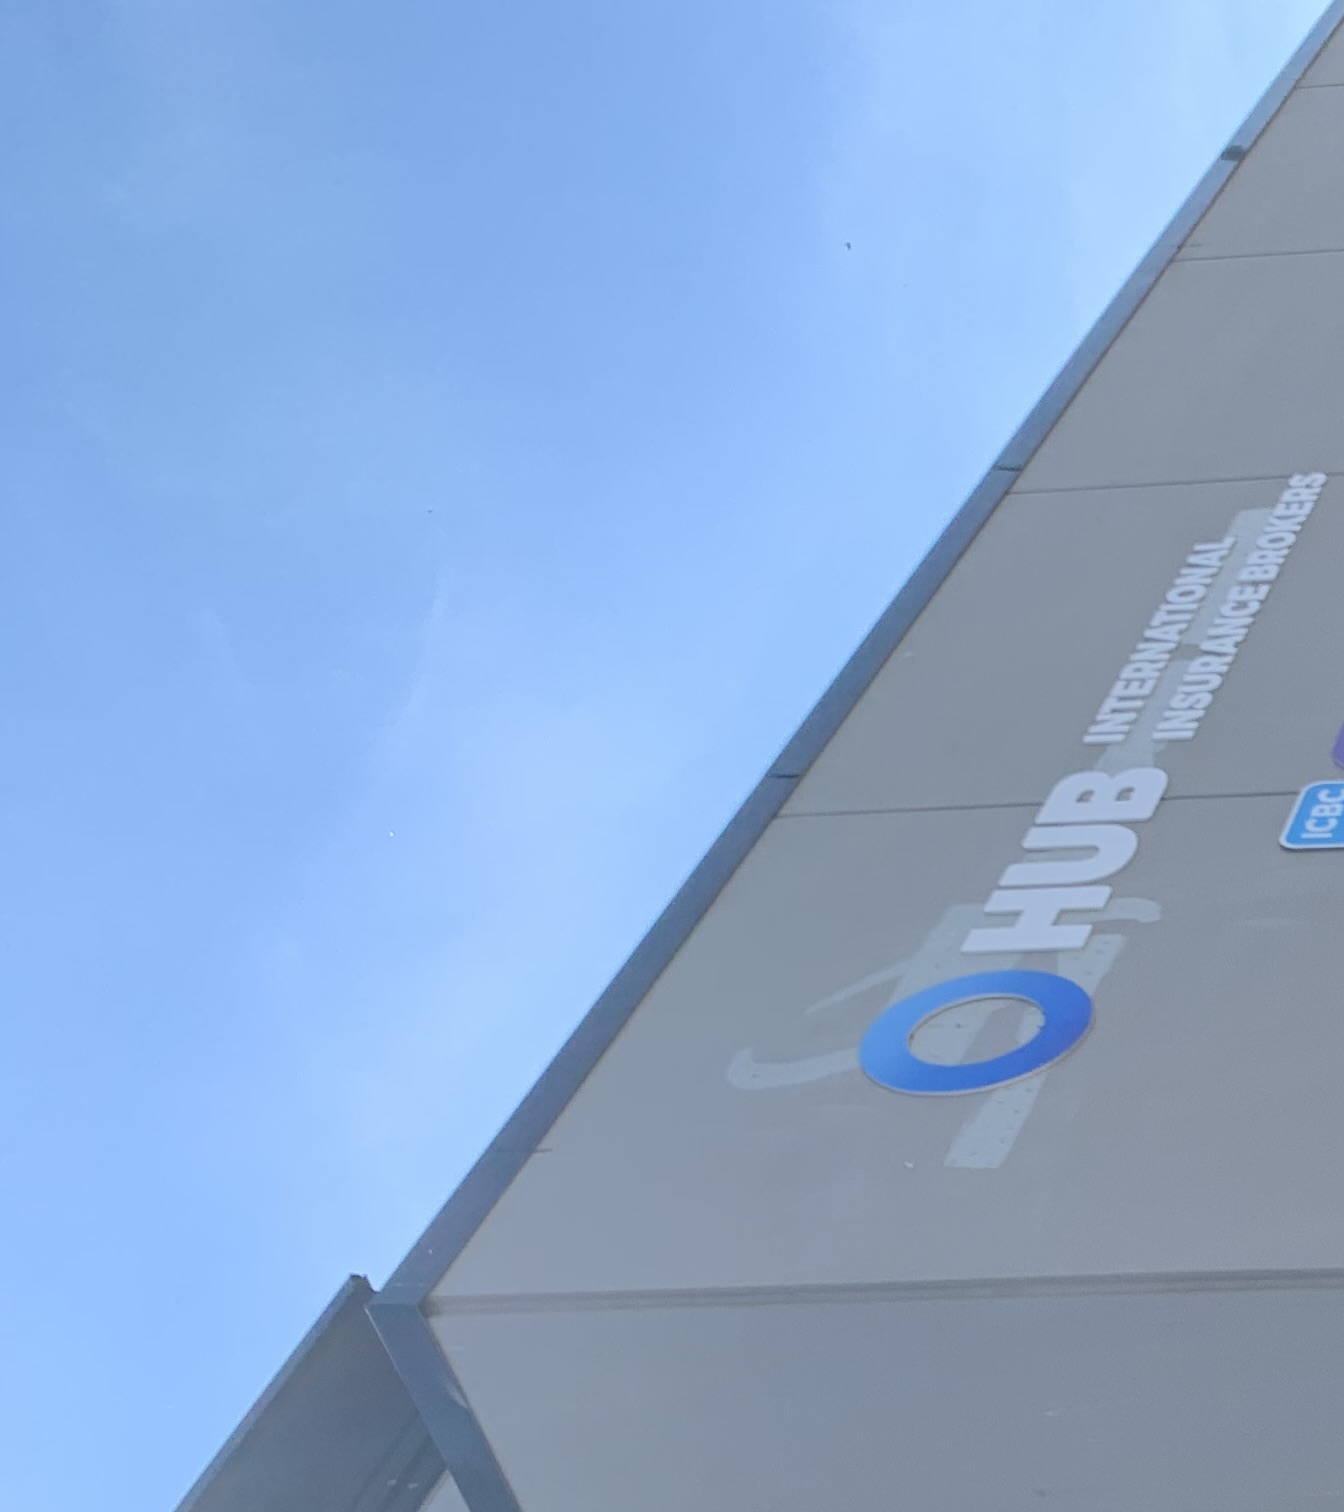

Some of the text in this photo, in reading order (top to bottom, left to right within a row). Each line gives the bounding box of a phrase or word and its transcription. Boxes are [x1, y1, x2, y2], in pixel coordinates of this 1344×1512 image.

[1082, 536, 1236, 744] INTERNATIONAL
[1151, 472, 1328, 740] INSURANCE BROKERS
[960, 767, 1168, 953] HUB
